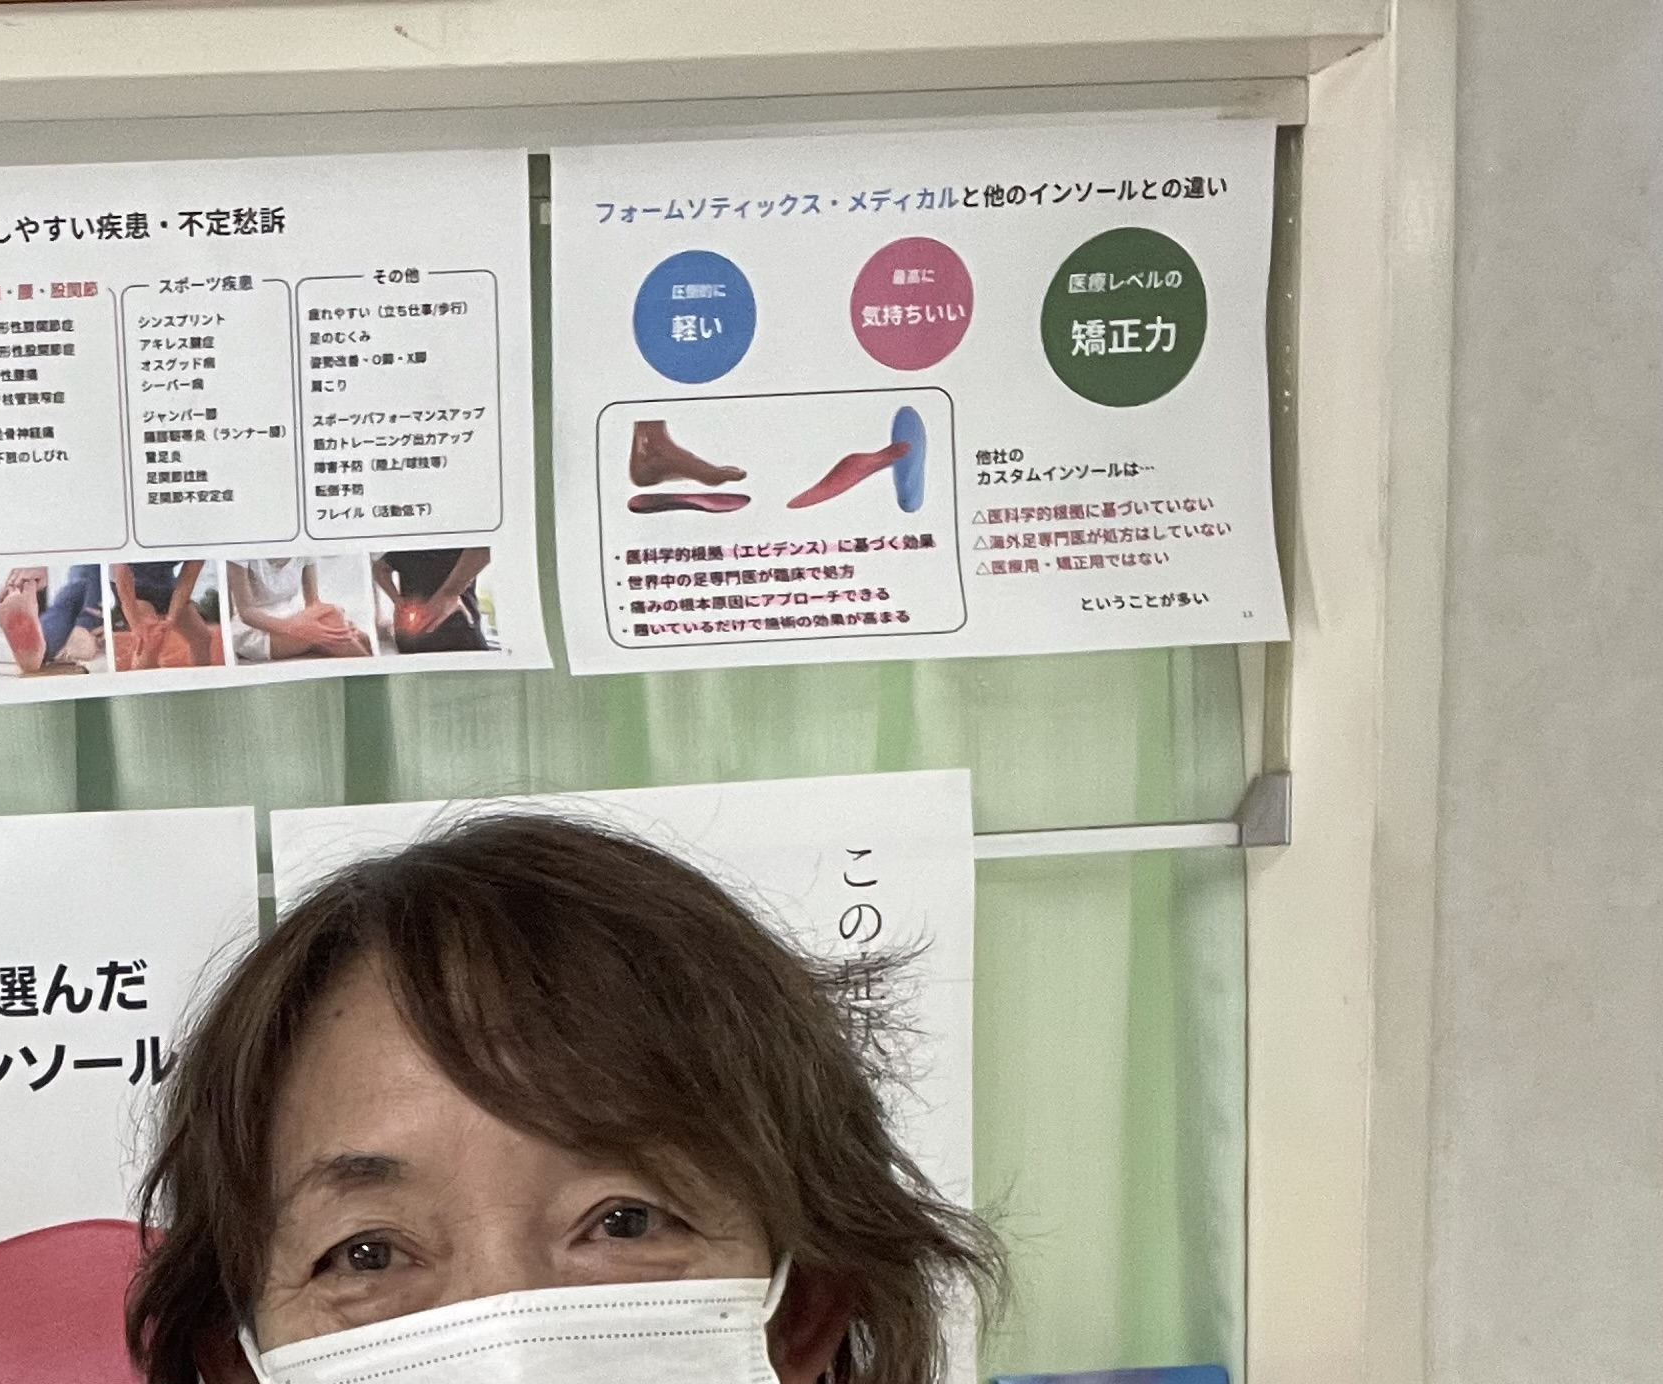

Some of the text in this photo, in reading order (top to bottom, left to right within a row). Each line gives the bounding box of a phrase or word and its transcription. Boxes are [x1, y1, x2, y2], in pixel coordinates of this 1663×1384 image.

[595, 176, 1227, 223] フォームソティックス・メディカルと他のインソールとの違い
[159, 275, 254, 293] スポーツ疾患
[373, 268, 420, 285] その他
[1068, 270, 1183, 294] 医療レベルの
[138, 313, 226, 329] シンスプリント
[861, 303, 967, 329] 気持ちいい
[309, 330, 371, 345] 足のむくみ
[671, 314, 723, 342] 軽い
[1071, 316, 1177, 357] 矯正力
[312, 406, 485, 428] スポーツパフォーマンスアップ
[975, 448, 1024, 466] 他社の
[1081, 593, 1210, 612] ということが多い
